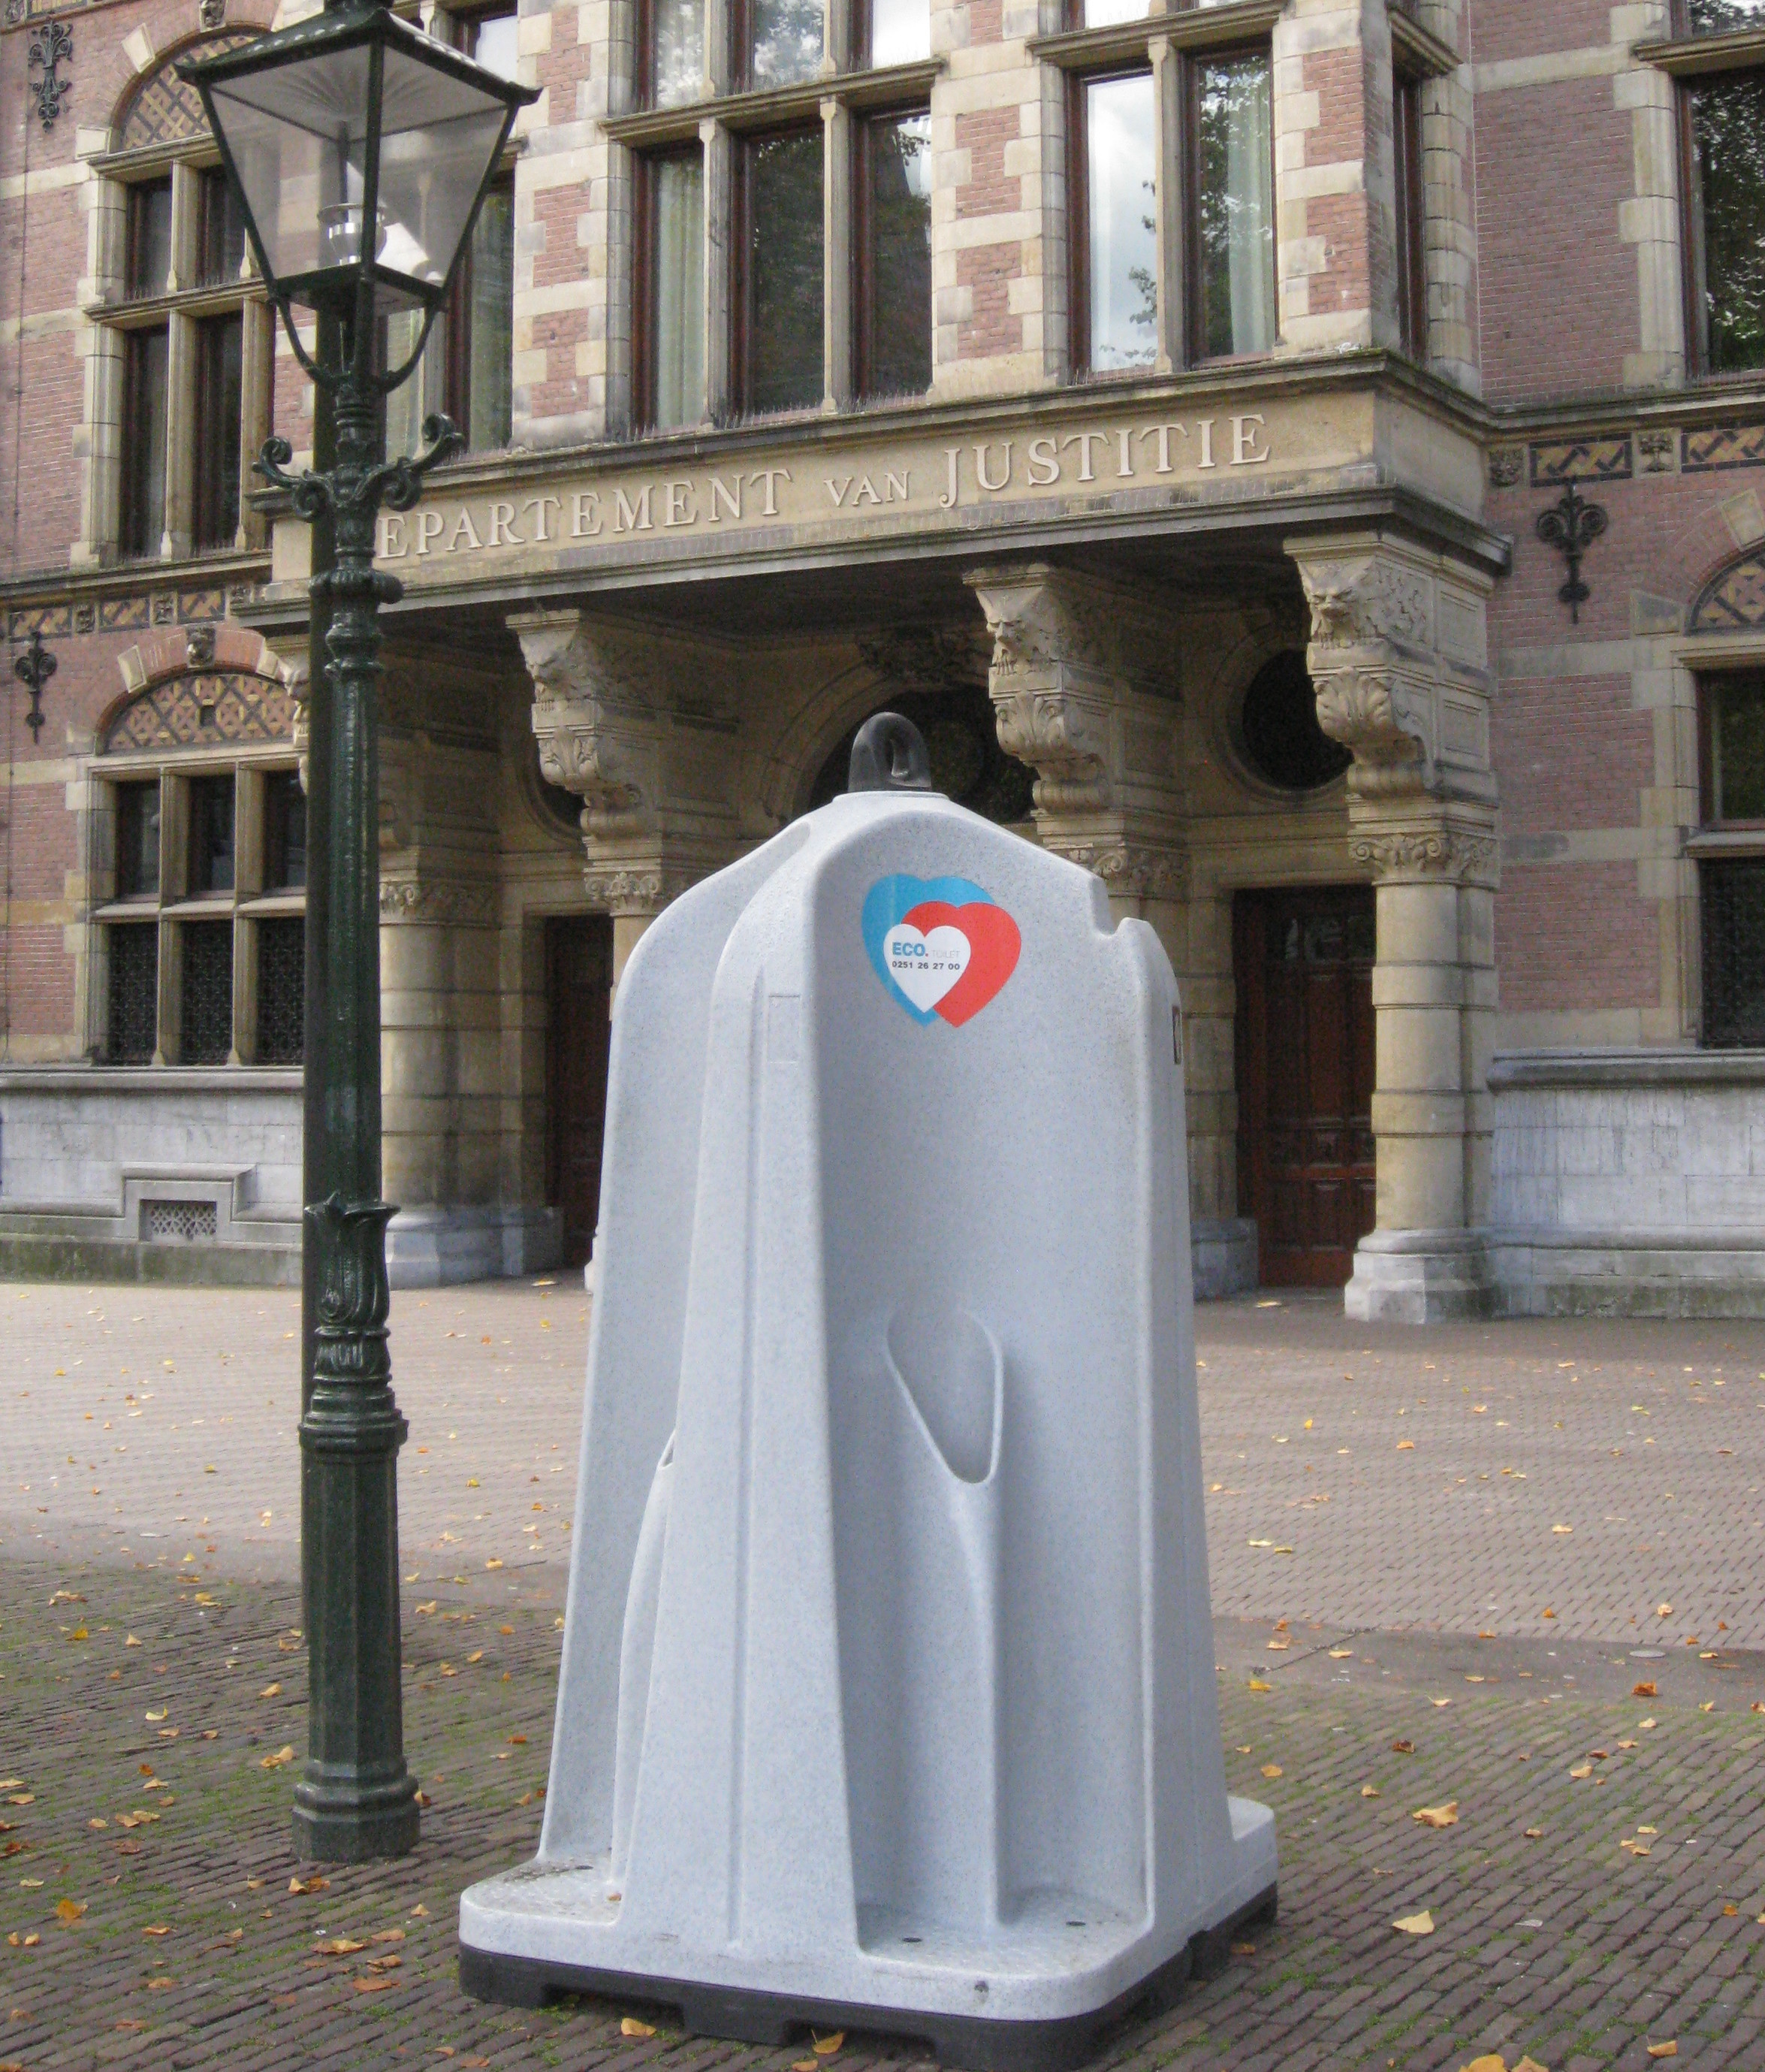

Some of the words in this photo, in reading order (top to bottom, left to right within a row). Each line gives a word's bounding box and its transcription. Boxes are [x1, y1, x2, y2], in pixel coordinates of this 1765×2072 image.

[377, 468, 792, 559] EPARTEMENT
[823, 470, 910, 507] VAN
[940, 413, 1271, 509] JUSTITIE
[931, 950, 961, 959] TOILET
[892, 960, 913, 968] 0251
[918, 962, 929, 970] 26
